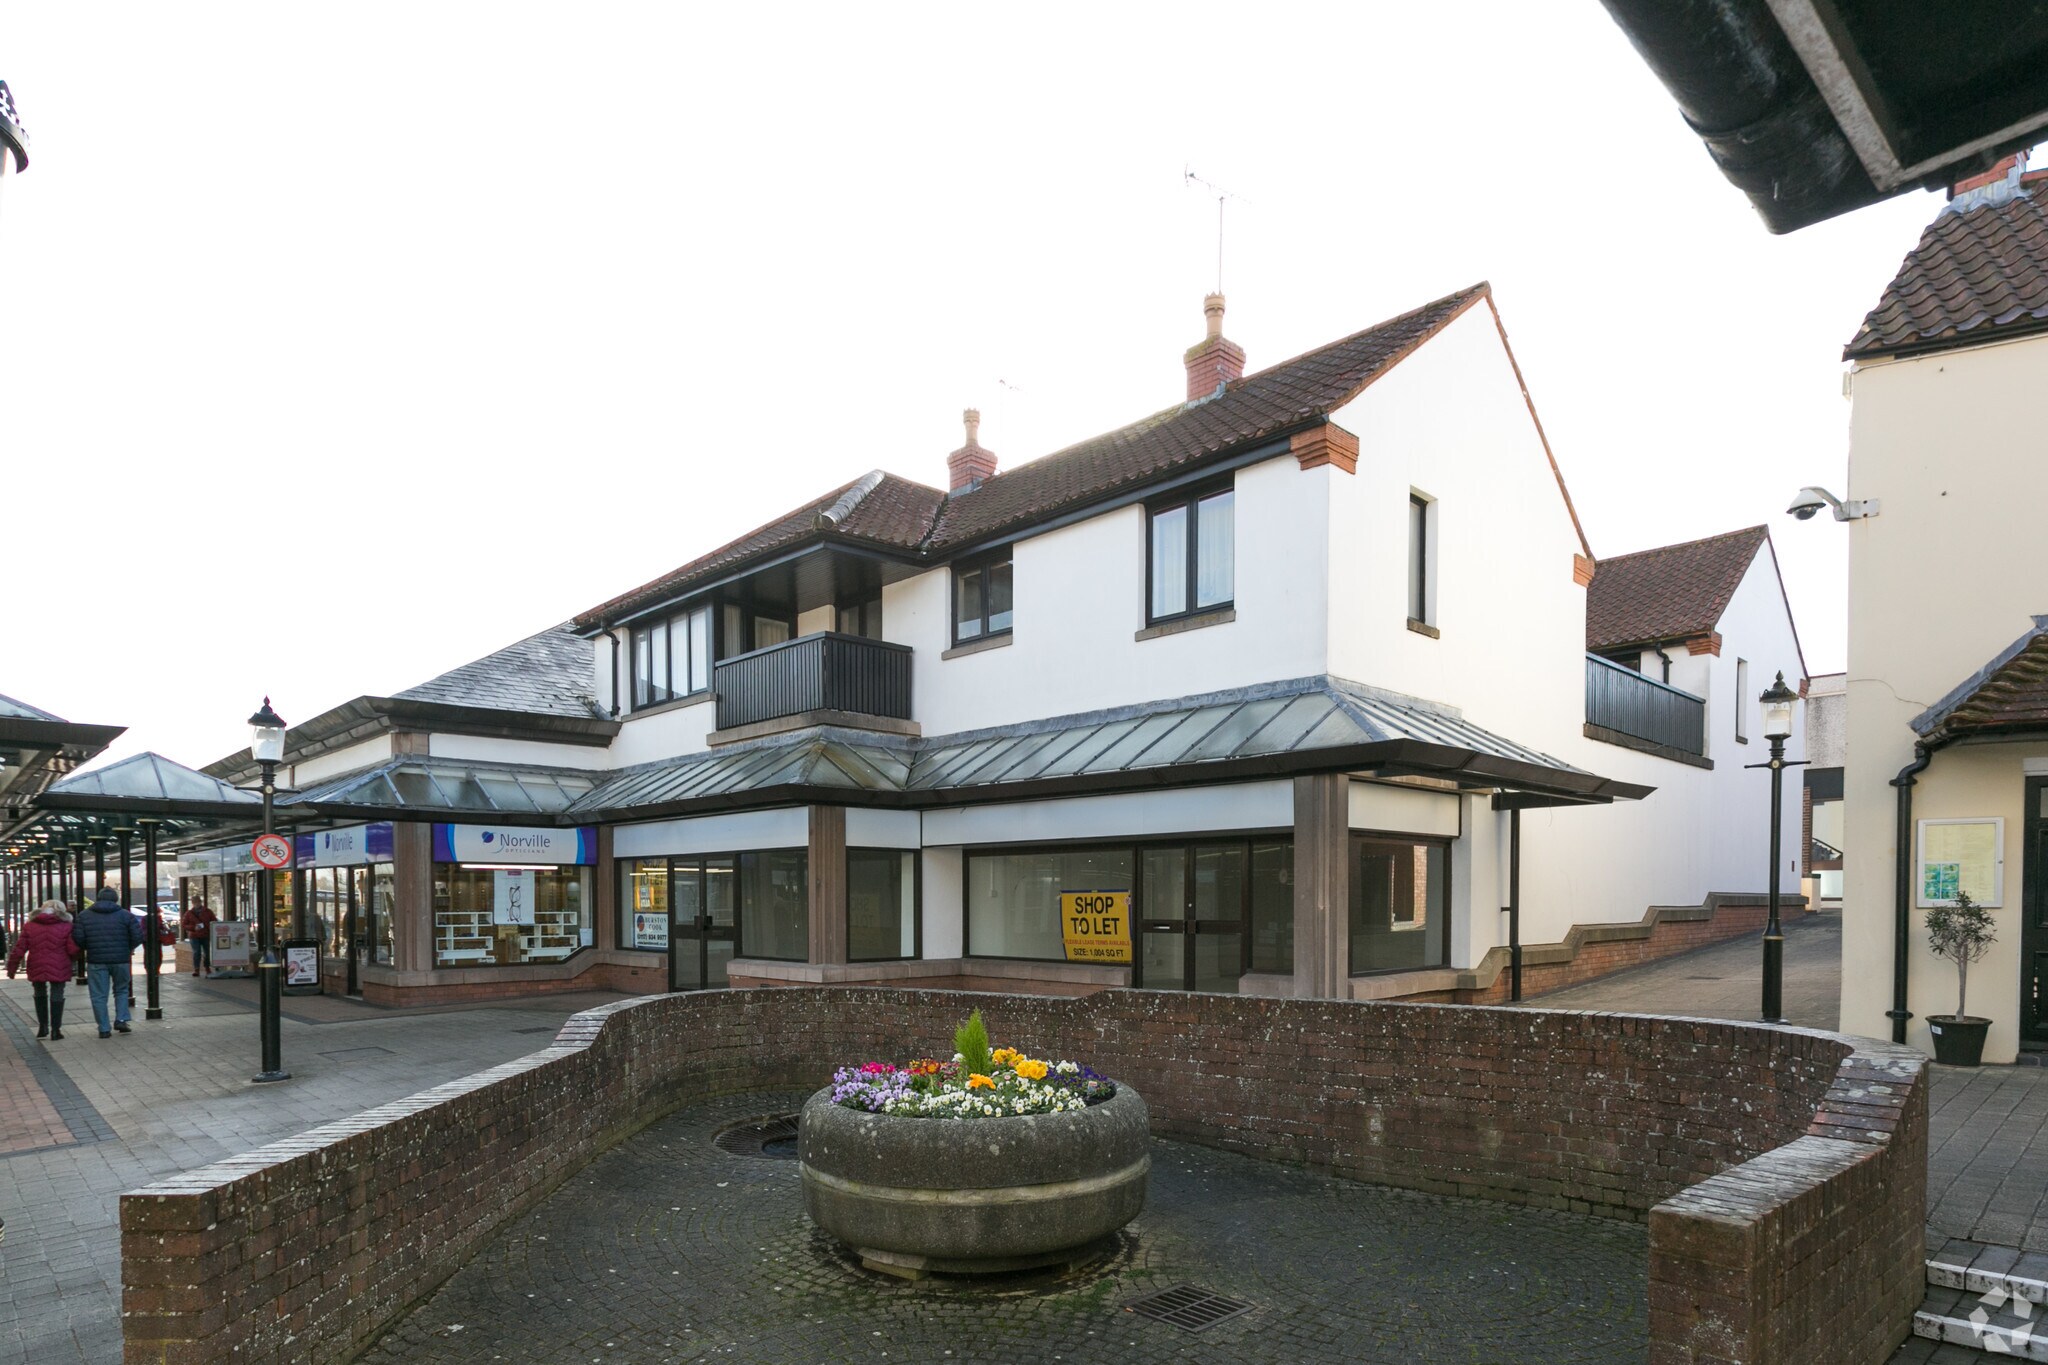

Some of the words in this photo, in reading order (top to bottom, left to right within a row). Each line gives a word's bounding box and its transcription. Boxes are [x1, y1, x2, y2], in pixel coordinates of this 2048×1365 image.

[332, 832, 353, 852] Norville
[500, 833, 551, 848] Norville
[1075, 896, 1114, 914] SHOP
[649, 923, 662, 931] COOK
[1071, 917, 1089, 935] TO
[1093, 917, 1120, 935] LET
[1073, 948, 1088, 956] SIZE:
[1105, 949, 1115, 957] SQ
[1116, 949, 1124, 957] FT
